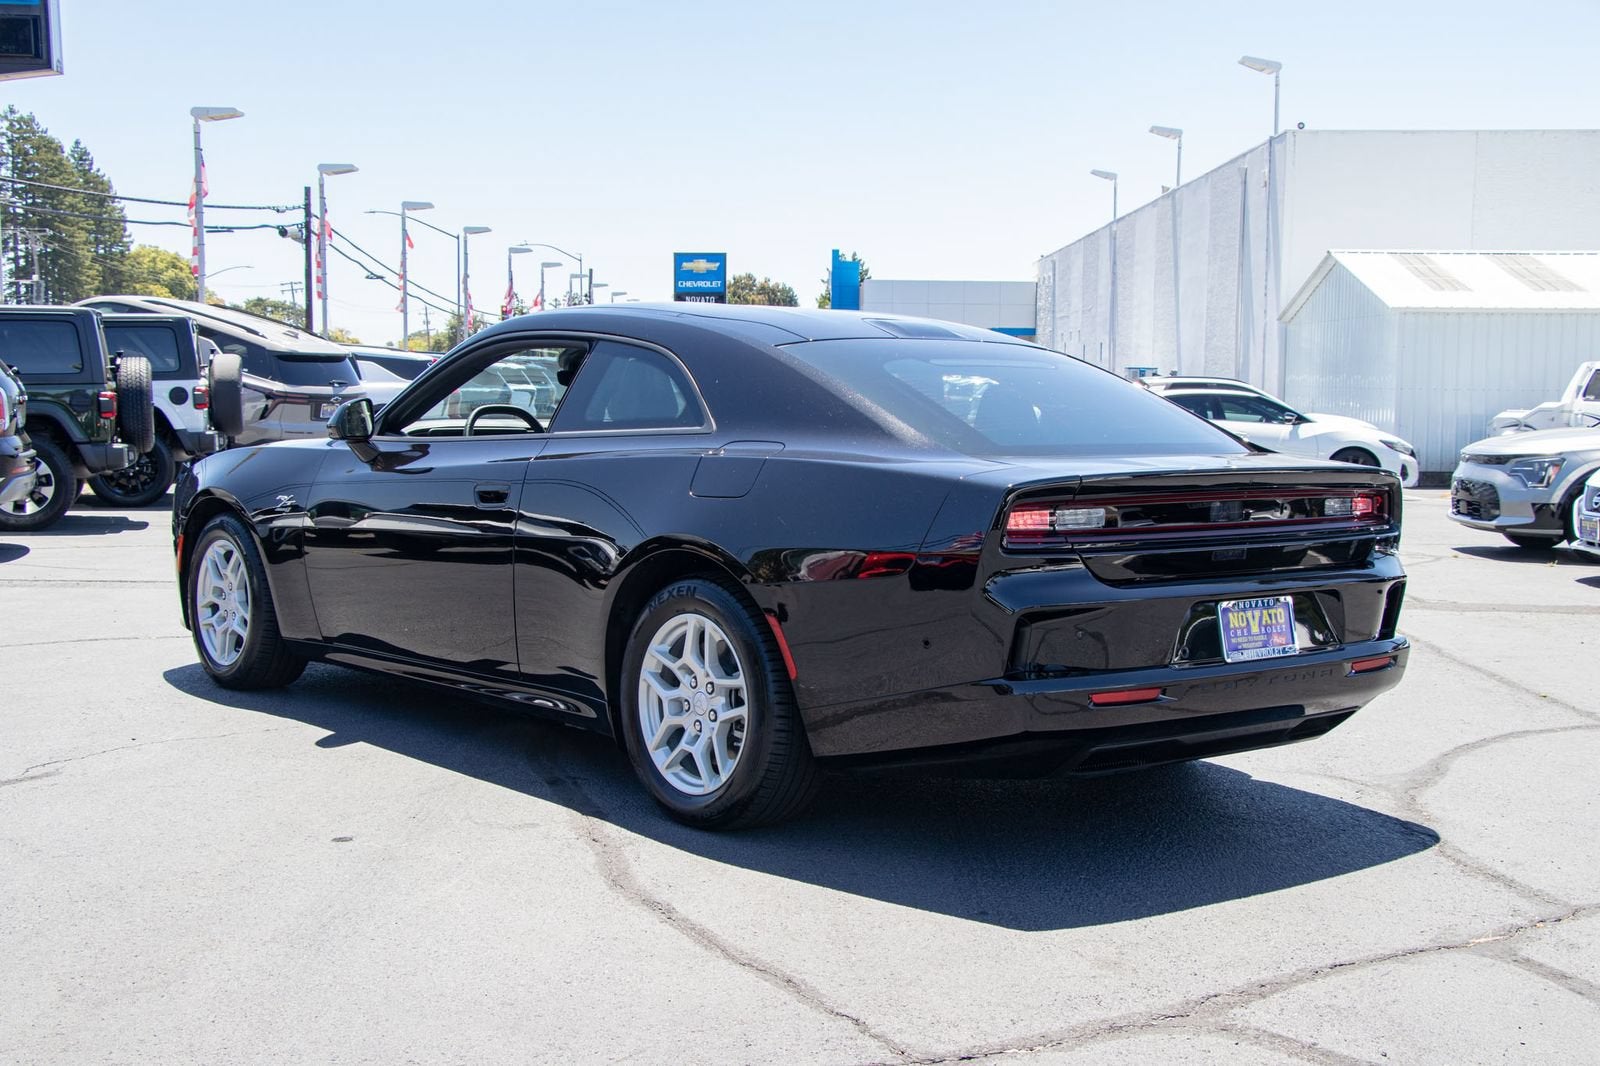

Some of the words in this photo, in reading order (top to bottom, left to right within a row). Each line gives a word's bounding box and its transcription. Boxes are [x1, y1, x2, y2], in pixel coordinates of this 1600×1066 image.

[685, 295, 716, 303] NOVATO
[649, 585, 697, 610] NEXEN
[1238, 598, 1275, 609] NOVATO
[1228, 607, 1285, 635] NOVATO
